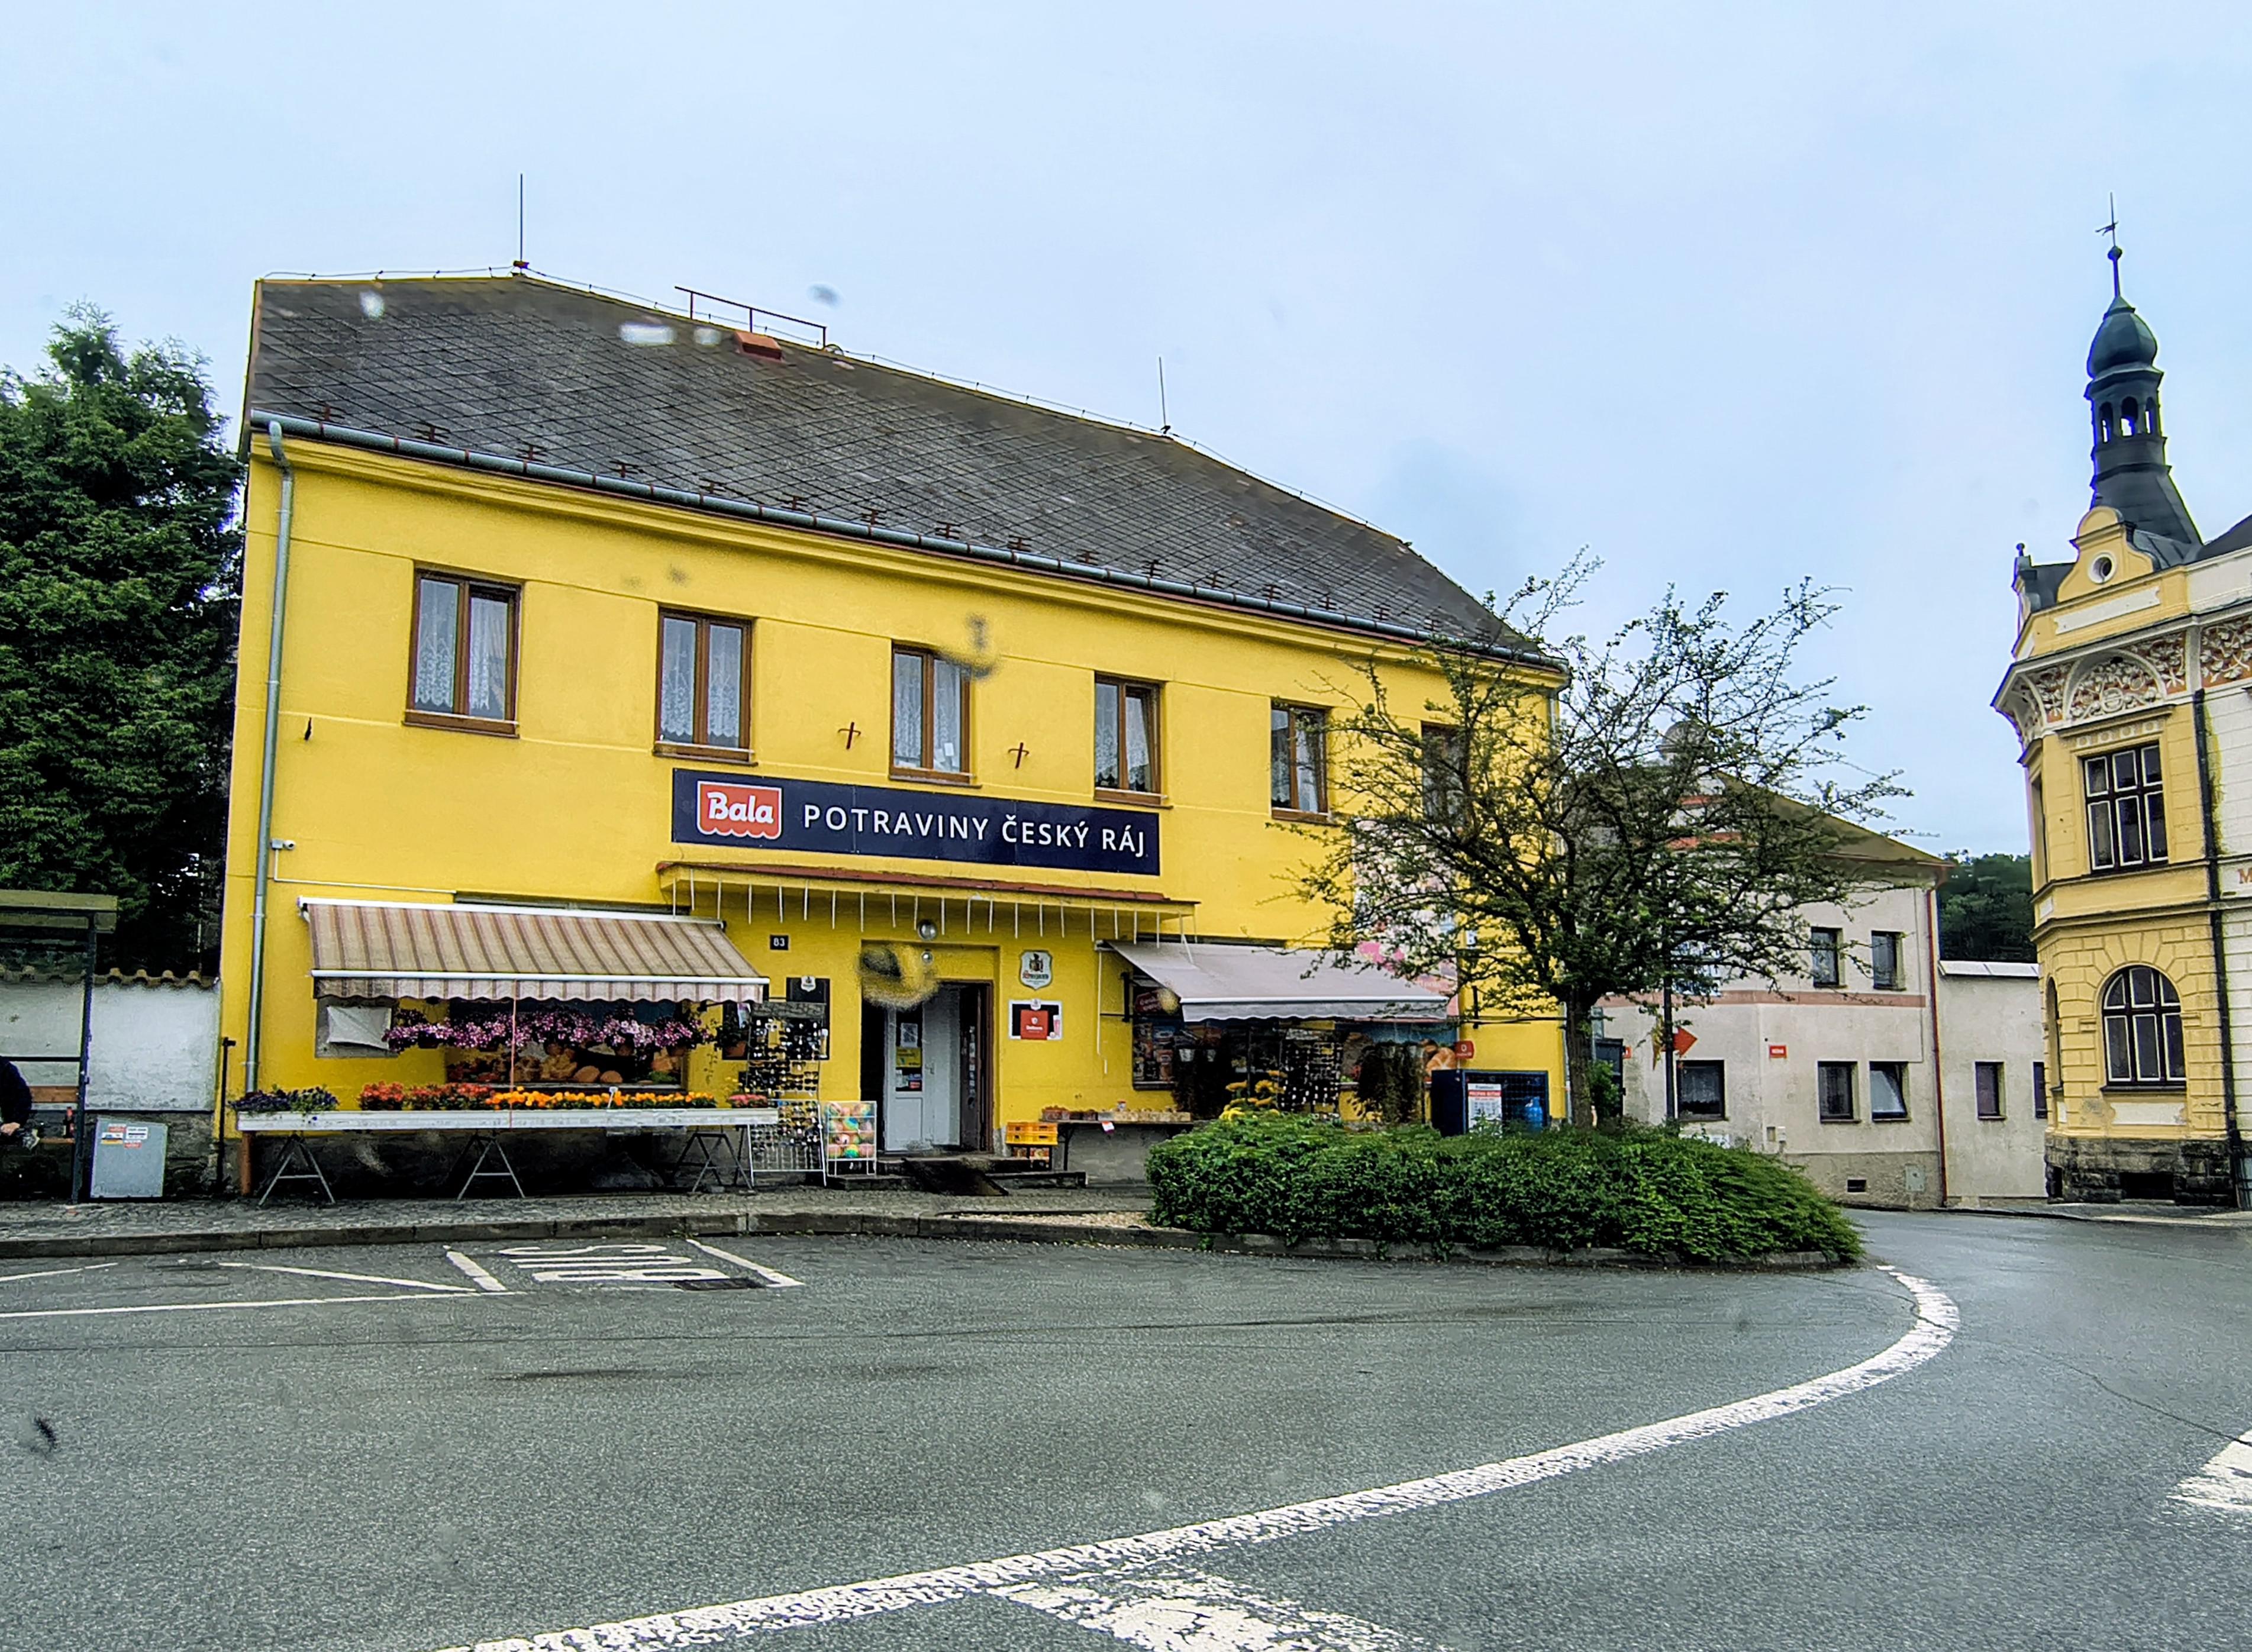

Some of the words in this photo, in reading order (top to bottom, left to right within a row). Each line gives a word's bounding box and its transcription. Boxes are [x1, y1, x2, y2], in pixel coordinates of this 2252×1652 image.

[707, 792, 774, 824] Bala
[804, 804, 988, 840] POTRAVINY
[1002, 814, 1089, 848] ČESKÝ
[1102, 825, 1144, 857] RÁJ
[773, 937, 785, 947] 83
[498, 1244, 730, 1282] BUS
